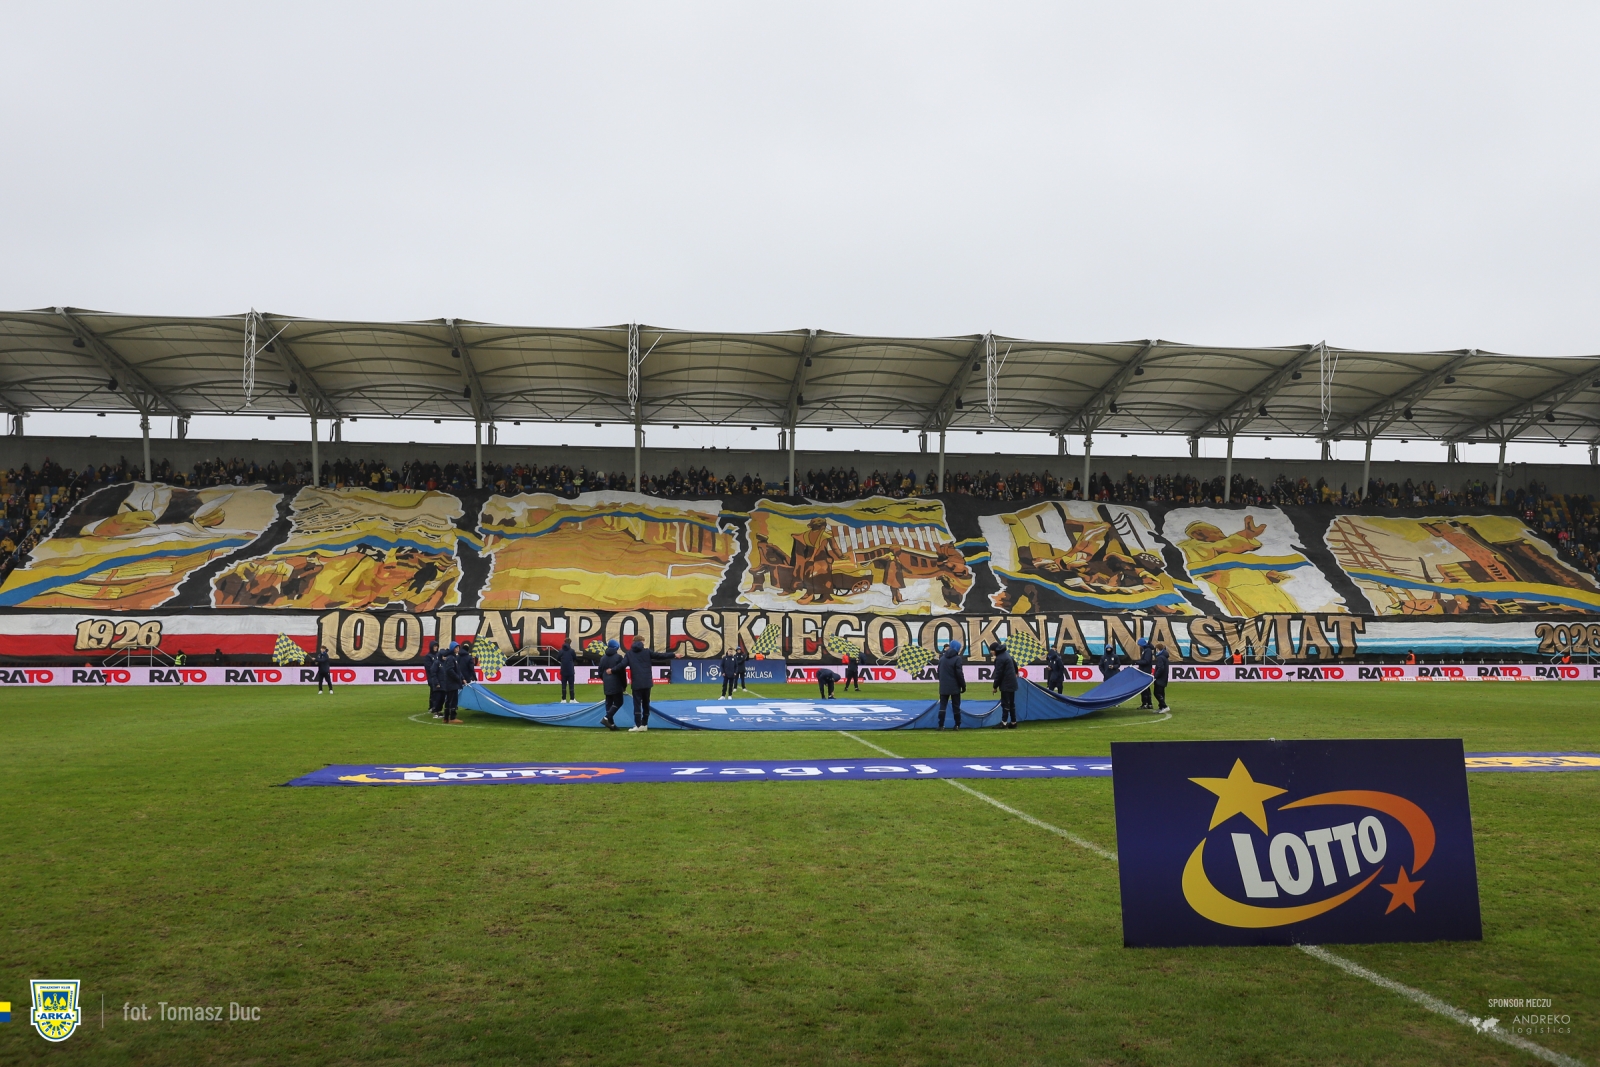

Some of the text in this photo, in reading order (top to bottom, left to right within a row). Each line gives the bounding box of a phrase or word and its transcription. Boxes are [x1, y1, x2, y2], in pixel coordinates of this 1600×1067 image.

[74, 619, 162, 650] 1926
[320, 610, 421, 661] 100
[436, 610, 552, 657] LAT
[919, 613, 1091, 662] OKNA
[1102, 614, 1184, 662] NA
[1535, 622, 1600, 655] 2026
[0, 669, 54, 684] RATO
[72, 669, 131, 684] RATO
[149, 669, 207, 684] RATO
[224, 669, 282, 684] RATO
[1172, 667, 1221, 680] RATO
[1235, 667, 1283, 680] RATO
[1297, 667, 1345, 680] RATO
[1358, 667, 1405, 679] RATO
[1418, 667, 1464, 677] RATO
[1477, 667, 1522, 677] RATO
[1535, 667, 1580, 679] RATO
[404, 769, 571, 780] LOTTO
[670, 763, 1113, 775] zagraj tera
[1231, 815, 1387, 898] LOTTO
